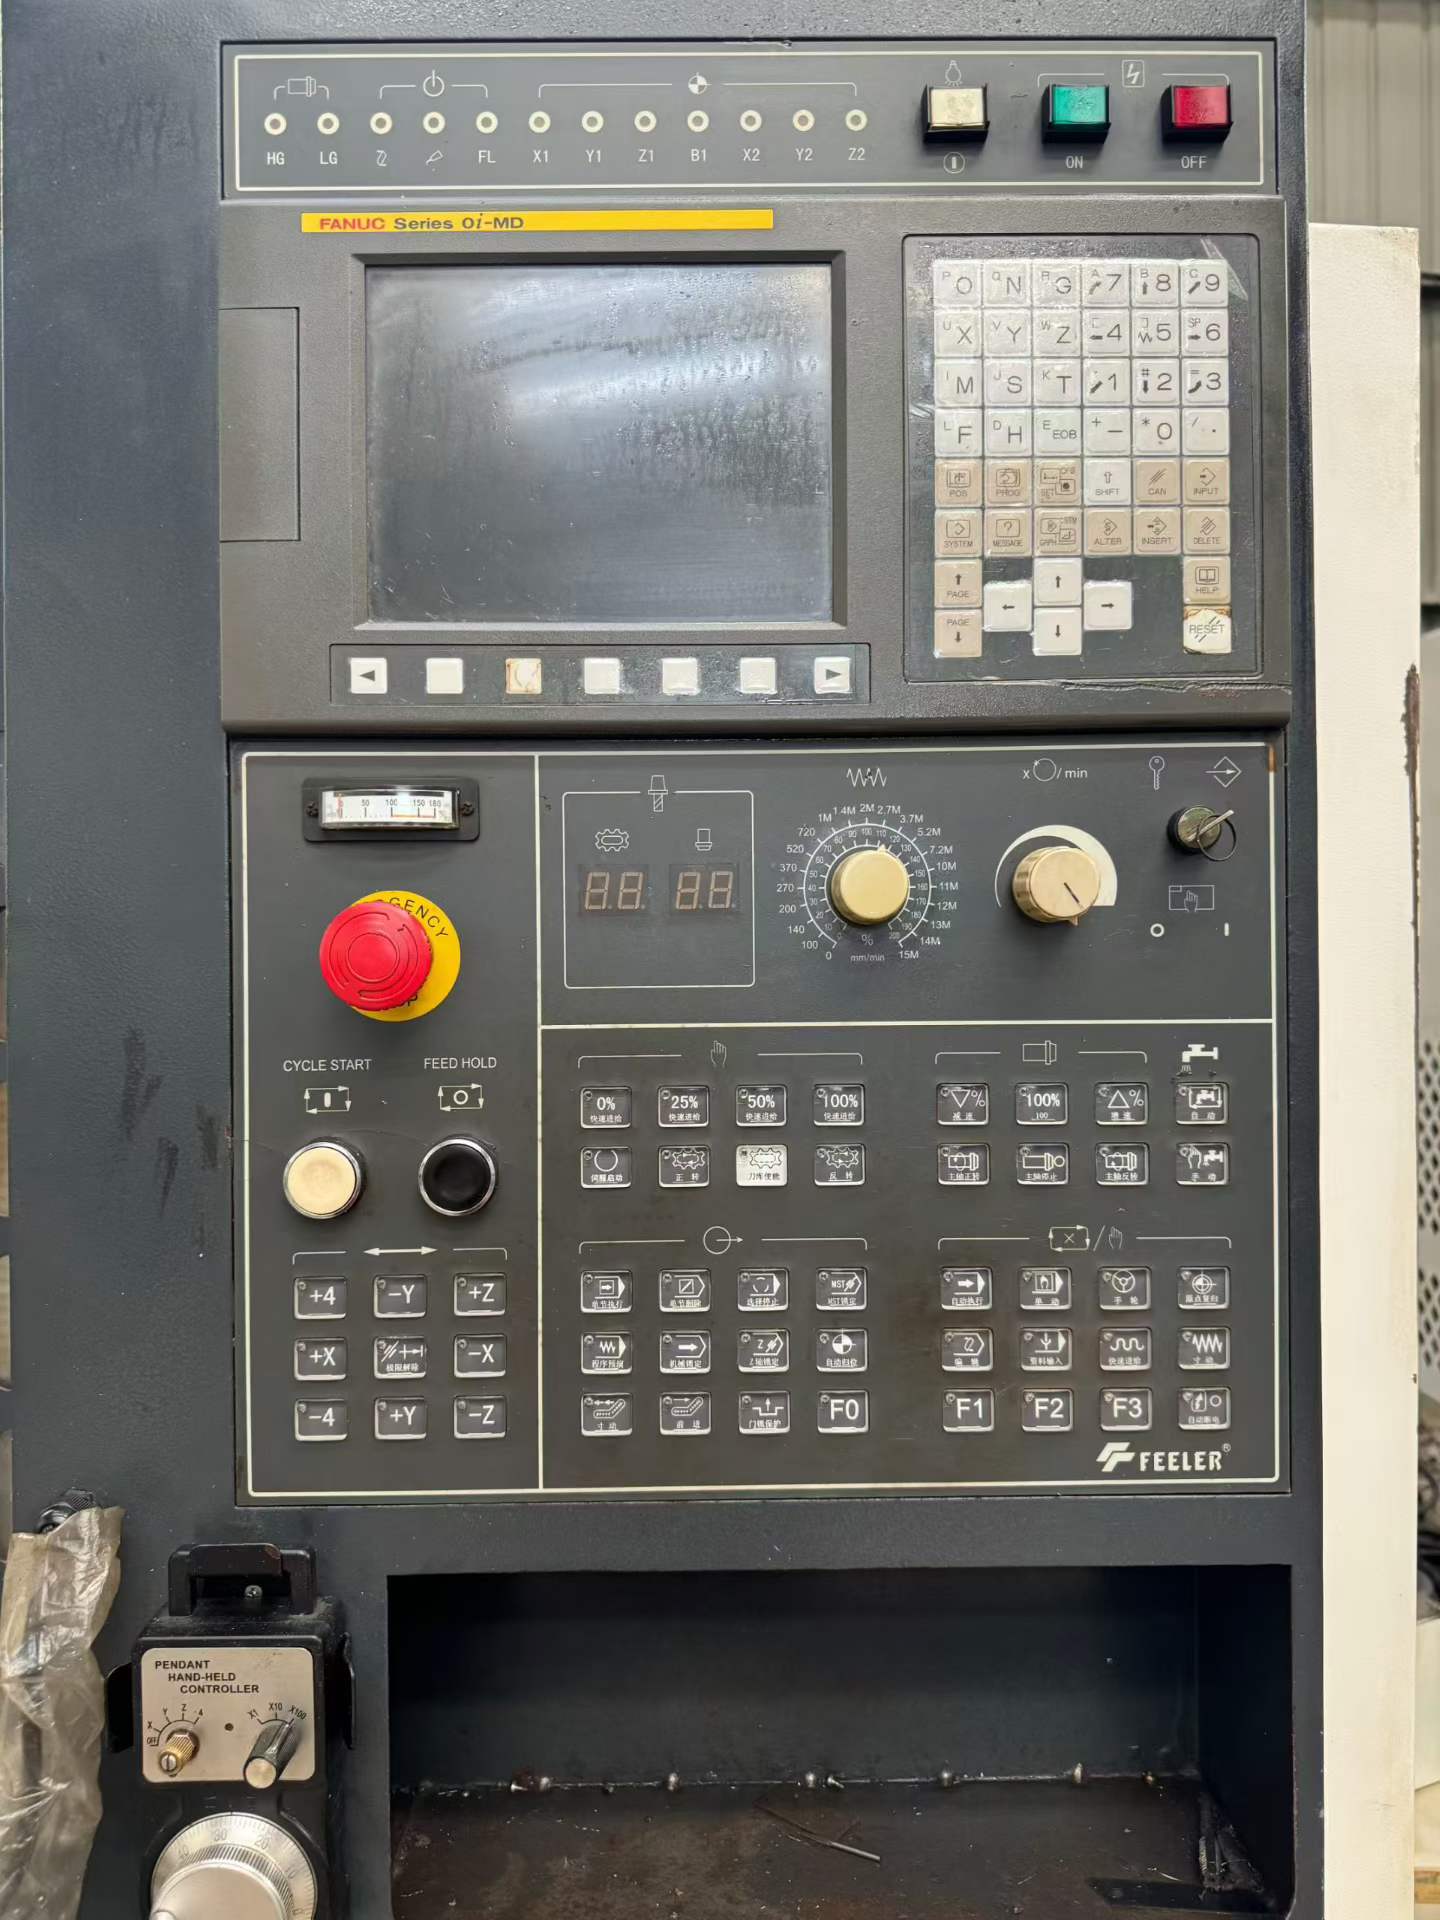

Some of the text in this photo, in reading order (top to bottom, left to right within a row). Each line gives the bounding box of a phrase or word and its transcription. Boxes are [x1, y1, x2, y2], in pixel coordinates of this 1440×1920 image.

[266, 151, 285, 166] HG
[320, 151, 338, 166] LG
[478, 151, 496, 164] FL
[533, 151, 549, 163] X1
[585, 150, 602, 163] Y1
[638, 150, 654, 162] Z1
[691, 149, 708, 162] B1
[742, 148, 760, 162] X2
[796, 148, 813, 161] Y2
[848, 148, 865, 161] Z2
[1065, 156, 1084, 169] ON
[1181, 156, 1207, 169] OFF
[319, 218, 386, 230] FANUC
[394, 217, 453, 230] Series
[1006, 276, 1021, 294] N
[1055, 276, 1072, 294] G
[1106, 274, 1122, 291] 7
[1156, 274, 1171, 291] 8
[1205, 274, 1220, 291] 9
[957, 326, 972, 344] X
[1007, 326, 1022, 344] Y
[1056, 326, 1071, 344] Z
[1106, 324, 1122, 341] 4
[1156, 324, 1171, 341] 5
[1205, 324, 1221, 341] 6
[957, 377, 973, 394] M
[1007, 376, 1022, 394] S
[1057, 376, 1072, 393] T
[1108, 374, 1117, 391] 1
[1157, 373, 1172, 391] 2
[1206, 373, 1221, 390] 3
[958, 426, 972, 443] F
[1008, 426, 1022, 443] H
[1053, 429, 1077, 439] EOB
[949, 488, 967, 497] POS
[995, 488, 1020, 497] PROG
[1096, 488, 1120, 496] SHIFT
[1148, 488, 1167, 496] CAN
[1193, 487, 1218, 495] INPUT
[944, 540, 973, 548] SYSTEM
[1095, 537, 1122, 545] ALTER
[1142, 536, 1172, 545] INSERT
[1193, 536, 1221, 545] DELETE
[947, 590, 968, 598] PAGE
[1196, 586, 1218, 594] HELP
[947, 618, 969, 626] PAGE
[1189, 624, 1224, 634] RESET
[386, 798, 397, 806] 100
[860, 804, 874, 812] 2M
[878, 805, 901, 814] 2.7M
[819, 814, 831, 822] 1M
[900, 814, 923, 823] 3.7M
[798, 827, 815, 837] 720
[848, 830, 856, 838] 90
[862, 828, 872, 836] 100
[876, 829, 886, 837] 110
[917, 827, 940, 836] 5.2M
[787, 845, 804, 854] 520
[901, 844, 912, 852] 130
[930, 846, 953, 854] 7.2M
[910, 855, 920, 863] 140
[780, 863, 797, 872] 370
[937, 862, 956, 871] 10M
[809, 870, 817, 878] 50
[915, 869, 925, 877] 150
[776, 883, 794, 892] 270
[808, 884, 817, 892] 40
[939, 882, 958, 891] 11M
[916, 897, 926, 905] 170
[937, 901, 957, 910] 12M
[779, 904, 796, 913] 200
[816, 911, 824, 919] 20
[911, 911, 922, 919] 180
[788, 925, 805, 934] 140
[931, 921, 951, 929] 13M
[802, 940, 818, 949] 100
[920, 937, 941, 946] 14M
[826, 952, 831, 960] 0
[851, 954, 884, 962] mm/min
[899, 951, 919, 959] 15M
[283, 1059, 372, 1071] CYCLE START
[424, 1057, 496, 1069] FEED HOLD
[596, 1096, 616, 1111] 0%
[671, 1096, 698, 1109] 25%
[748, 1095, 775, 1108] 50%
[823, 1094, 858, 1108] 100%
[1026, 1092, 1060, 1107] 100%
[832, 1280, 846, 1288] MST
[310, 1286, 336, 1305] +4
[468, 1284, 494, 1302] +Z
[310, 1347, 336, 1366] +X
[956, 1398, 983, 1419] F1
[1035, 1398, 1063, 1418] F2
[1113, 1398, 1142, 1418] F3
[390, 1406, 416, 1425] +Y
[1140, 1451, 1222, 1471] FEELER
[155, 1660, 210, 1669] PENDANT
[168, 1672, 236, 1682] HAND-HELD
[180, 1684, 259, 1693] CONTROLLER
[269, 1702, 282, 1711] X10
[248, 1710, 259, 1719] X1
[288, 1705, 307, 1720] X100
[147, 1721, 153, 1729] X
[147, 1737, 158, 1745] OFF
